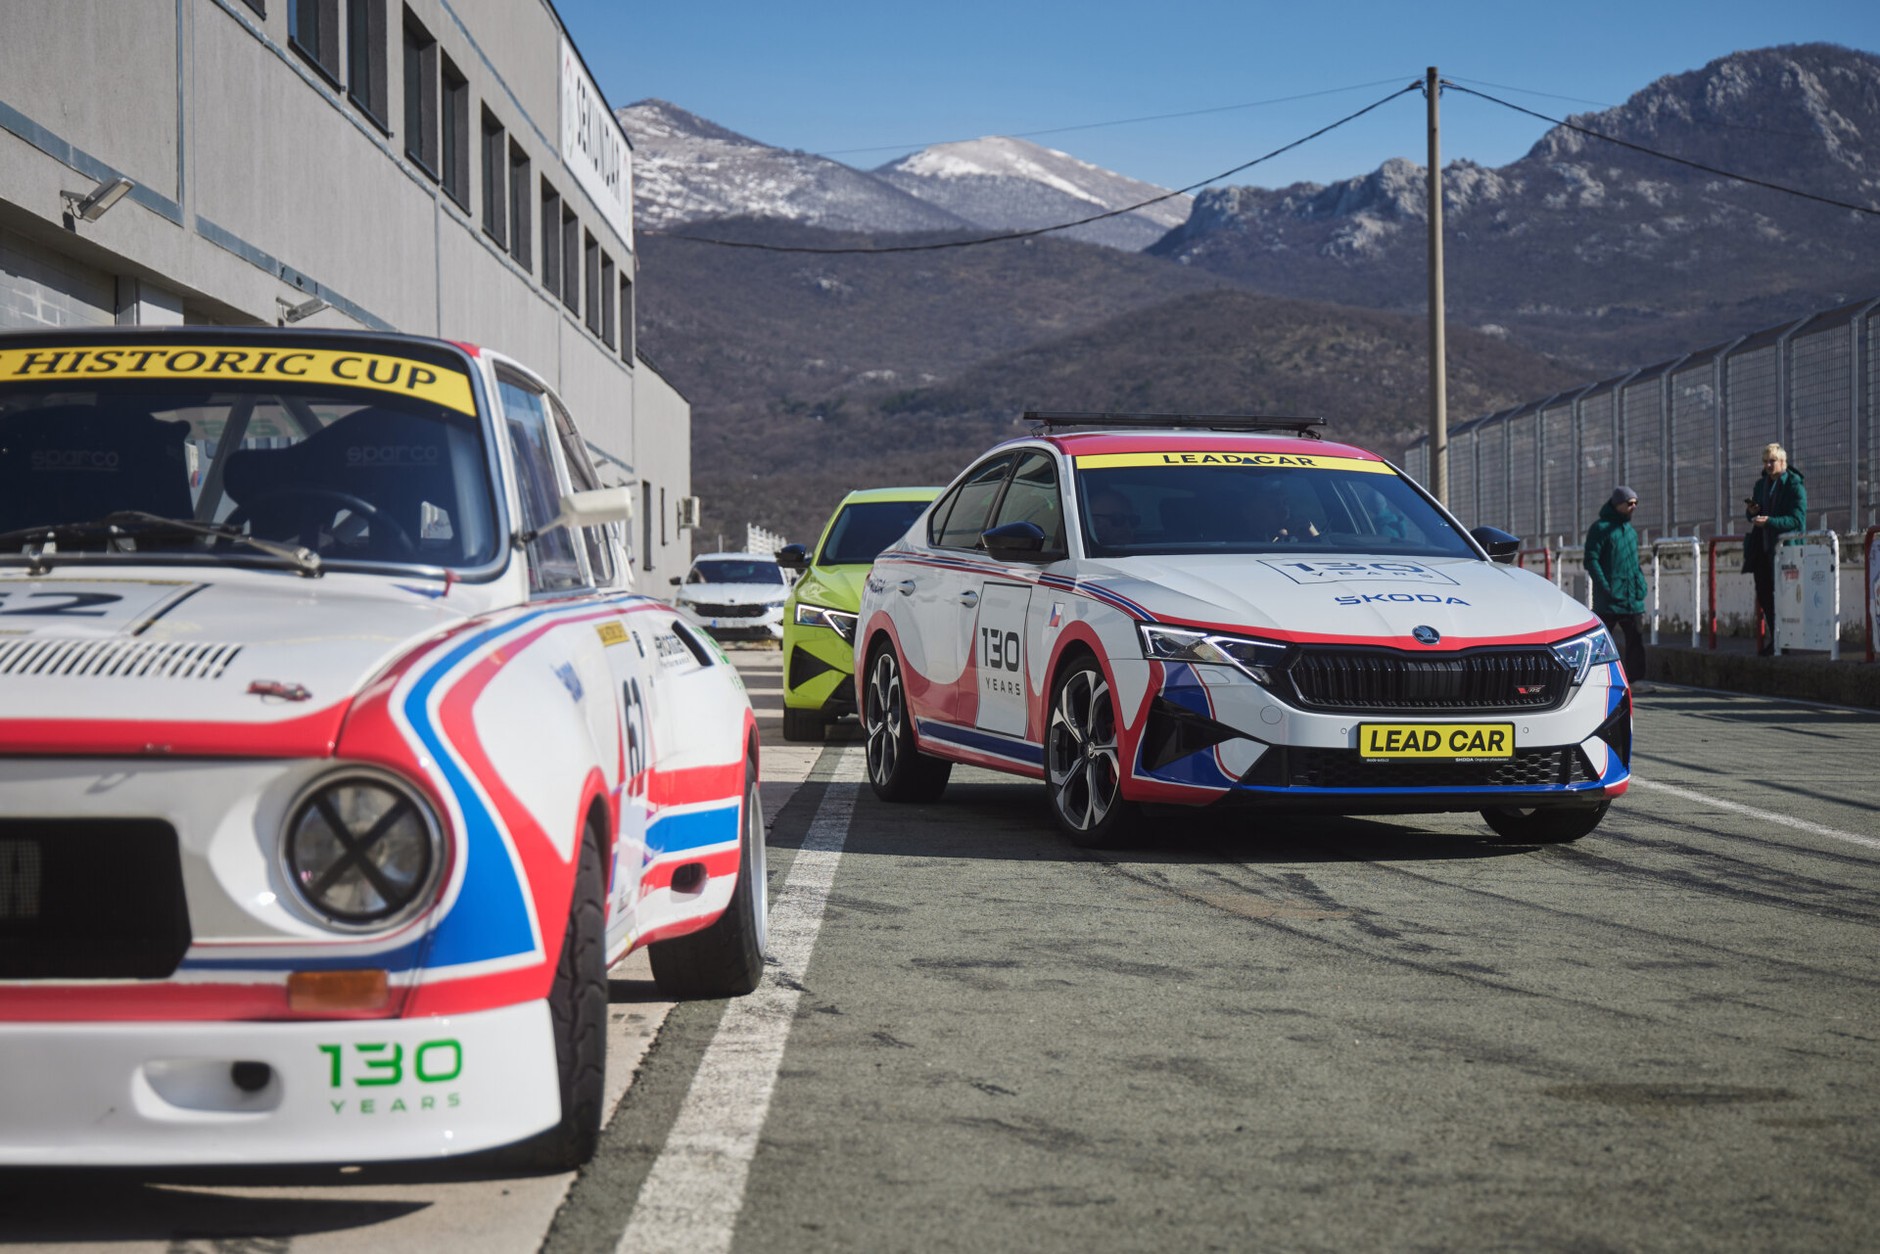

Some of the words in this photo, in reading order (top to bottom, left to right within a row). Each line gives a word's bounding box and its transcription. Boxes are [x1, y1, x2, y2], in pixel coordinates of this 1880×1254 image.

[12, 350, 315, 376] HISTORIC
[331, 357, 437, 389] CUP
[31, 450, 119, 470] sparco
[346, 446, 438, 466] sparco
[1163, 454, 1242, 465] LEAD
[1254, 455, 1318, 467] CAR
[1282, 562, 1425, 573] 130
[1311, 571, 1434, 579] YEARS
[0, 592, 124, 617] 2
[981, 627, 1020, 672] 130
[985, 677, 1021, 696] YEARS
[1369, 730, 1442, 752] LEAD
[1449, 730, 1505, 752] CAR
[317, 1039, 463, 1088] 130
[330, 1093, 461, 1115] YEARS
